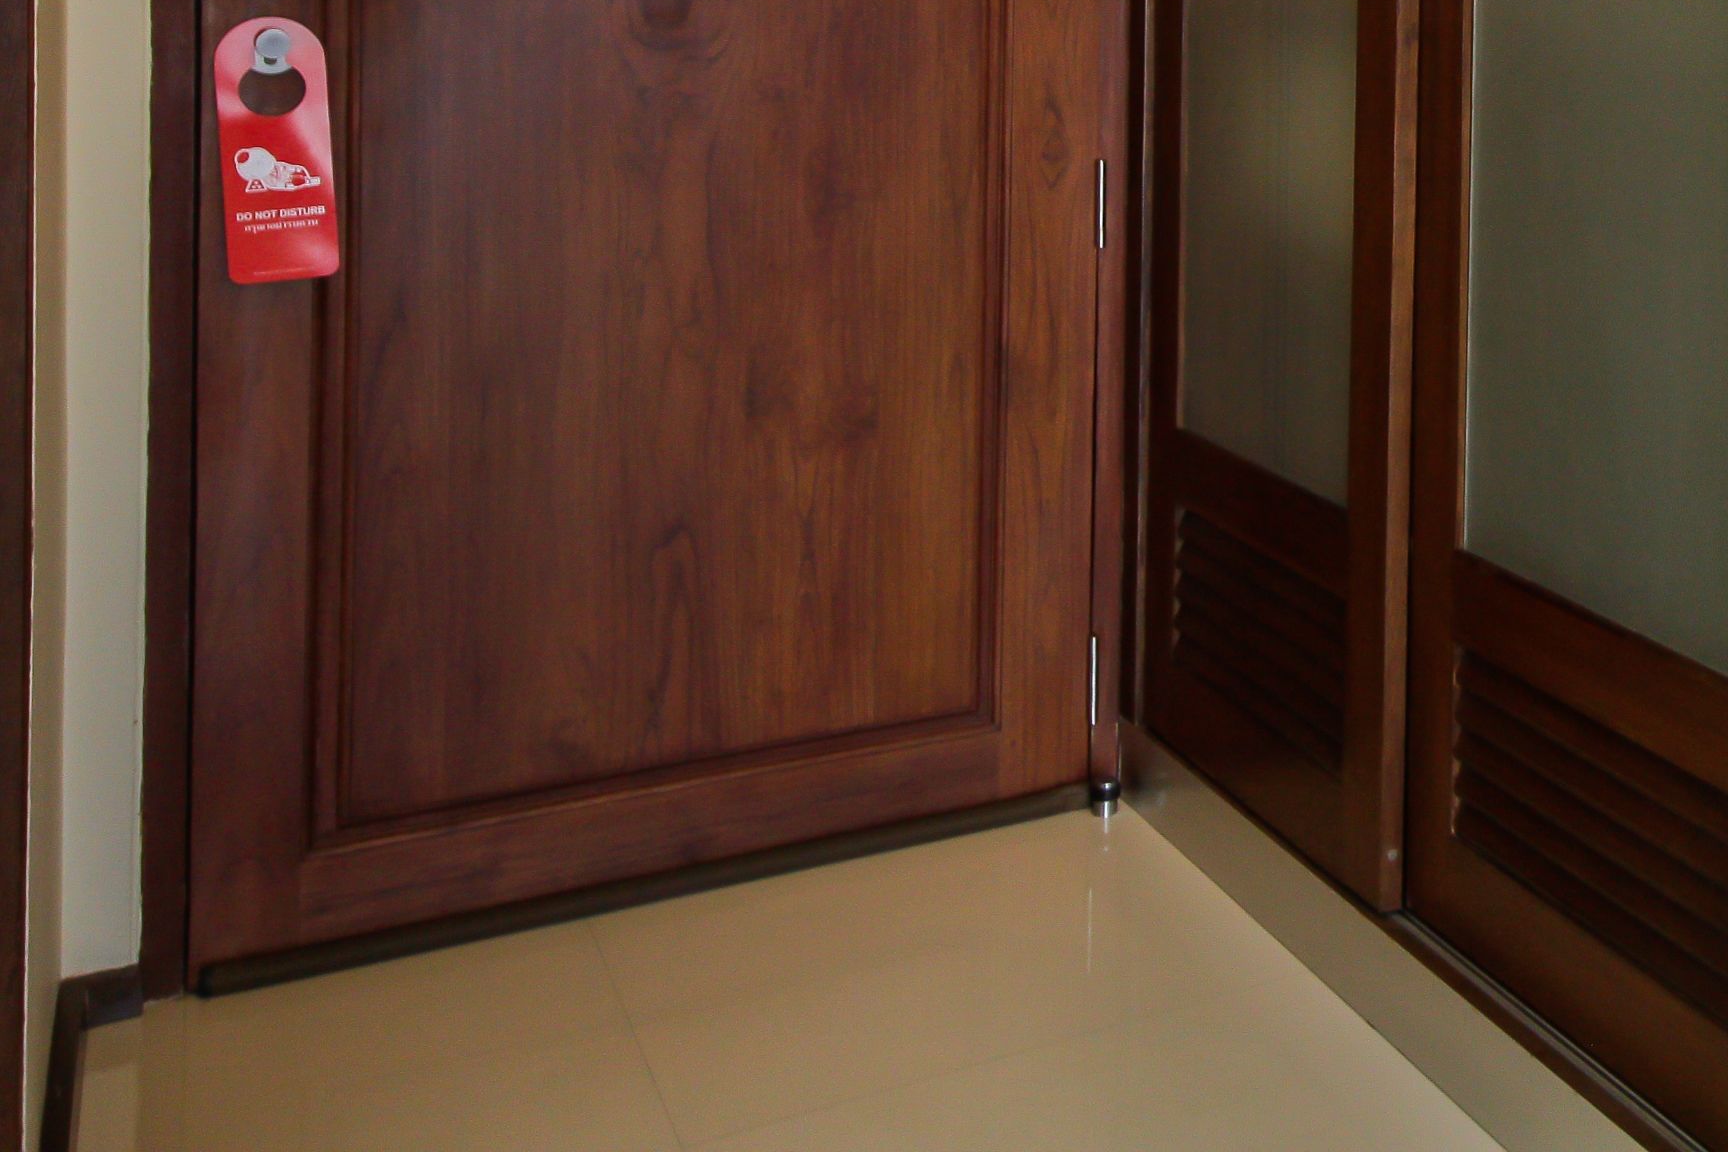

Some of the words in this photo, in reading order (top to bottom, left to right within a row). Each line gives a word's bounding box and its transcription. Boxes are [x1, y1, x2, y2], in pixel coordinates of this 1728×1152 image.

[236, 211, 252, 222] DO
[254, 209, 278, 220] NOT
[279, 205, 326, 218] DISTURB
